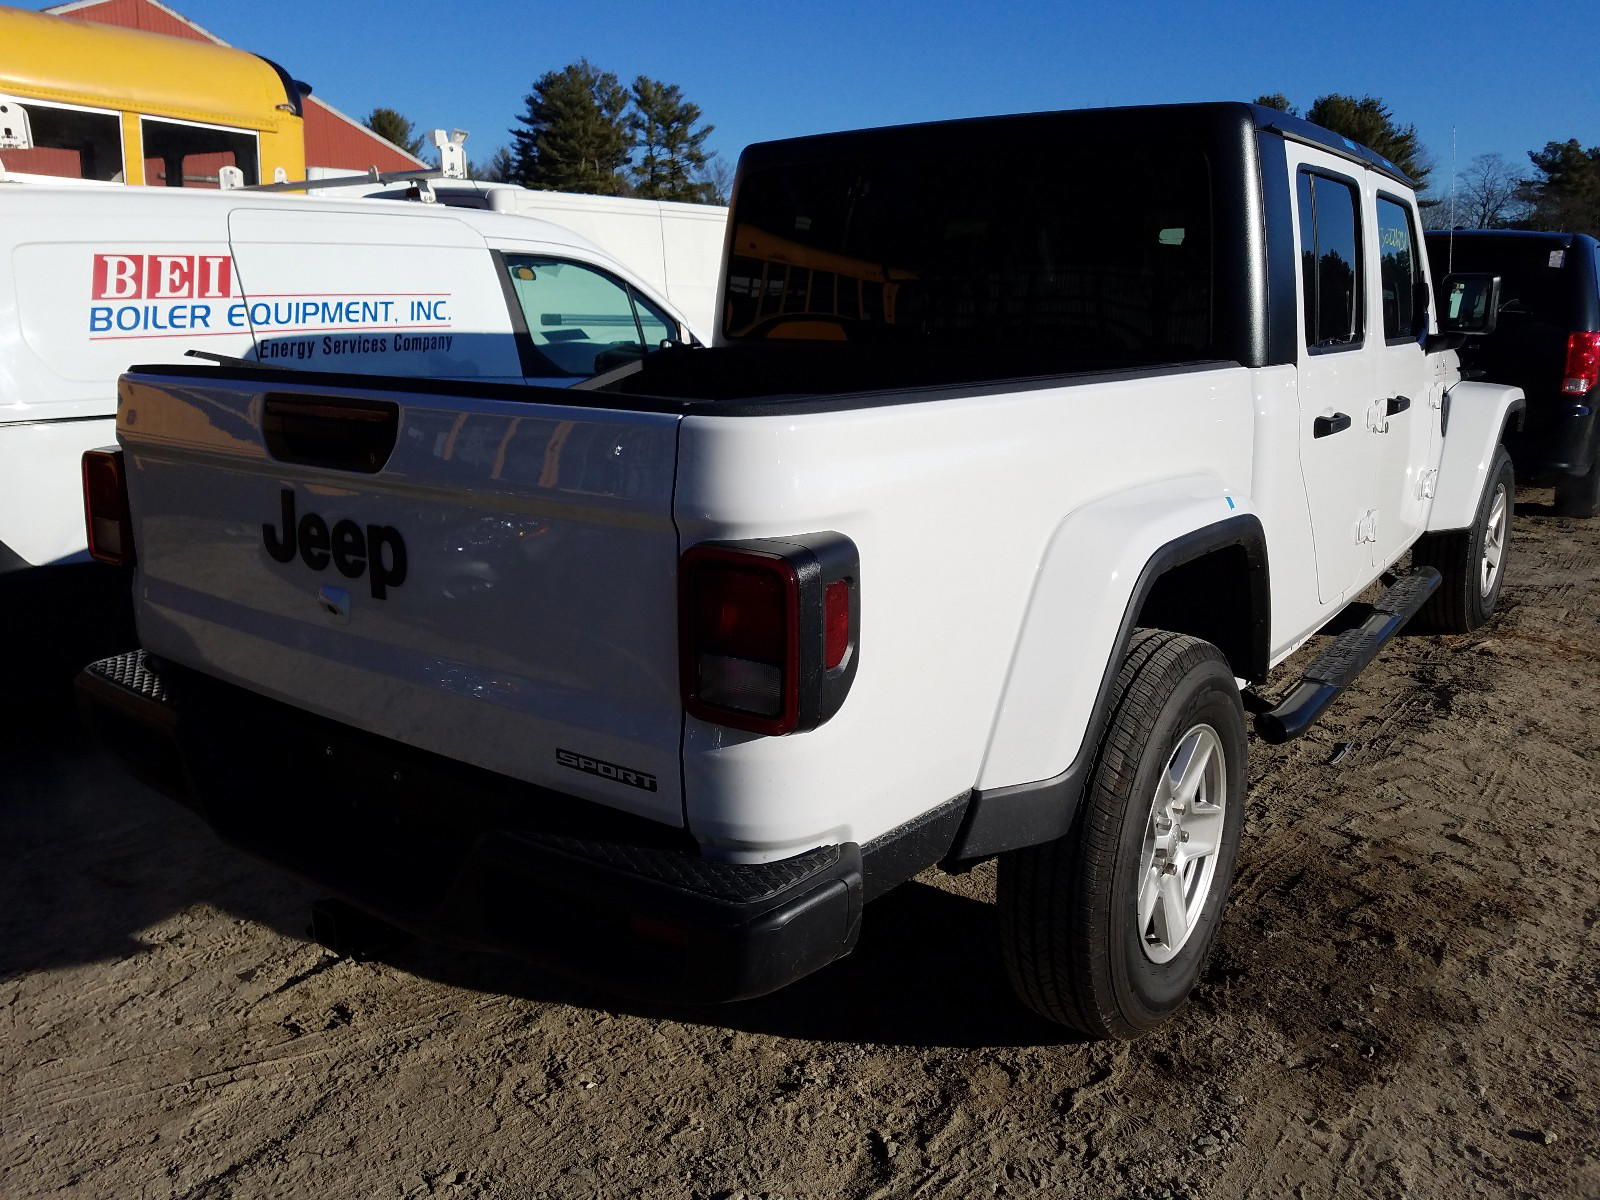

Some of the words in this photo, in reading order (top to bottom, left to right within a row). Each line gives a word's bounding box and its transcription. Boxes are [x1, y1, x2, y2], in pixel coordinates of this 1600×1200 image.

[100, 255, 224, 299] BEI
[89, 304, 212, 332] BOILER
[410, 300, 452, 322] INC.
[259, 339, 316, 360] Energy
[322, 335, 388, 356] Services
[393, 333, 453, 353] Company
[261, 487, 408, 601] Jeep
[556, 749, 657, 790] SPORT
